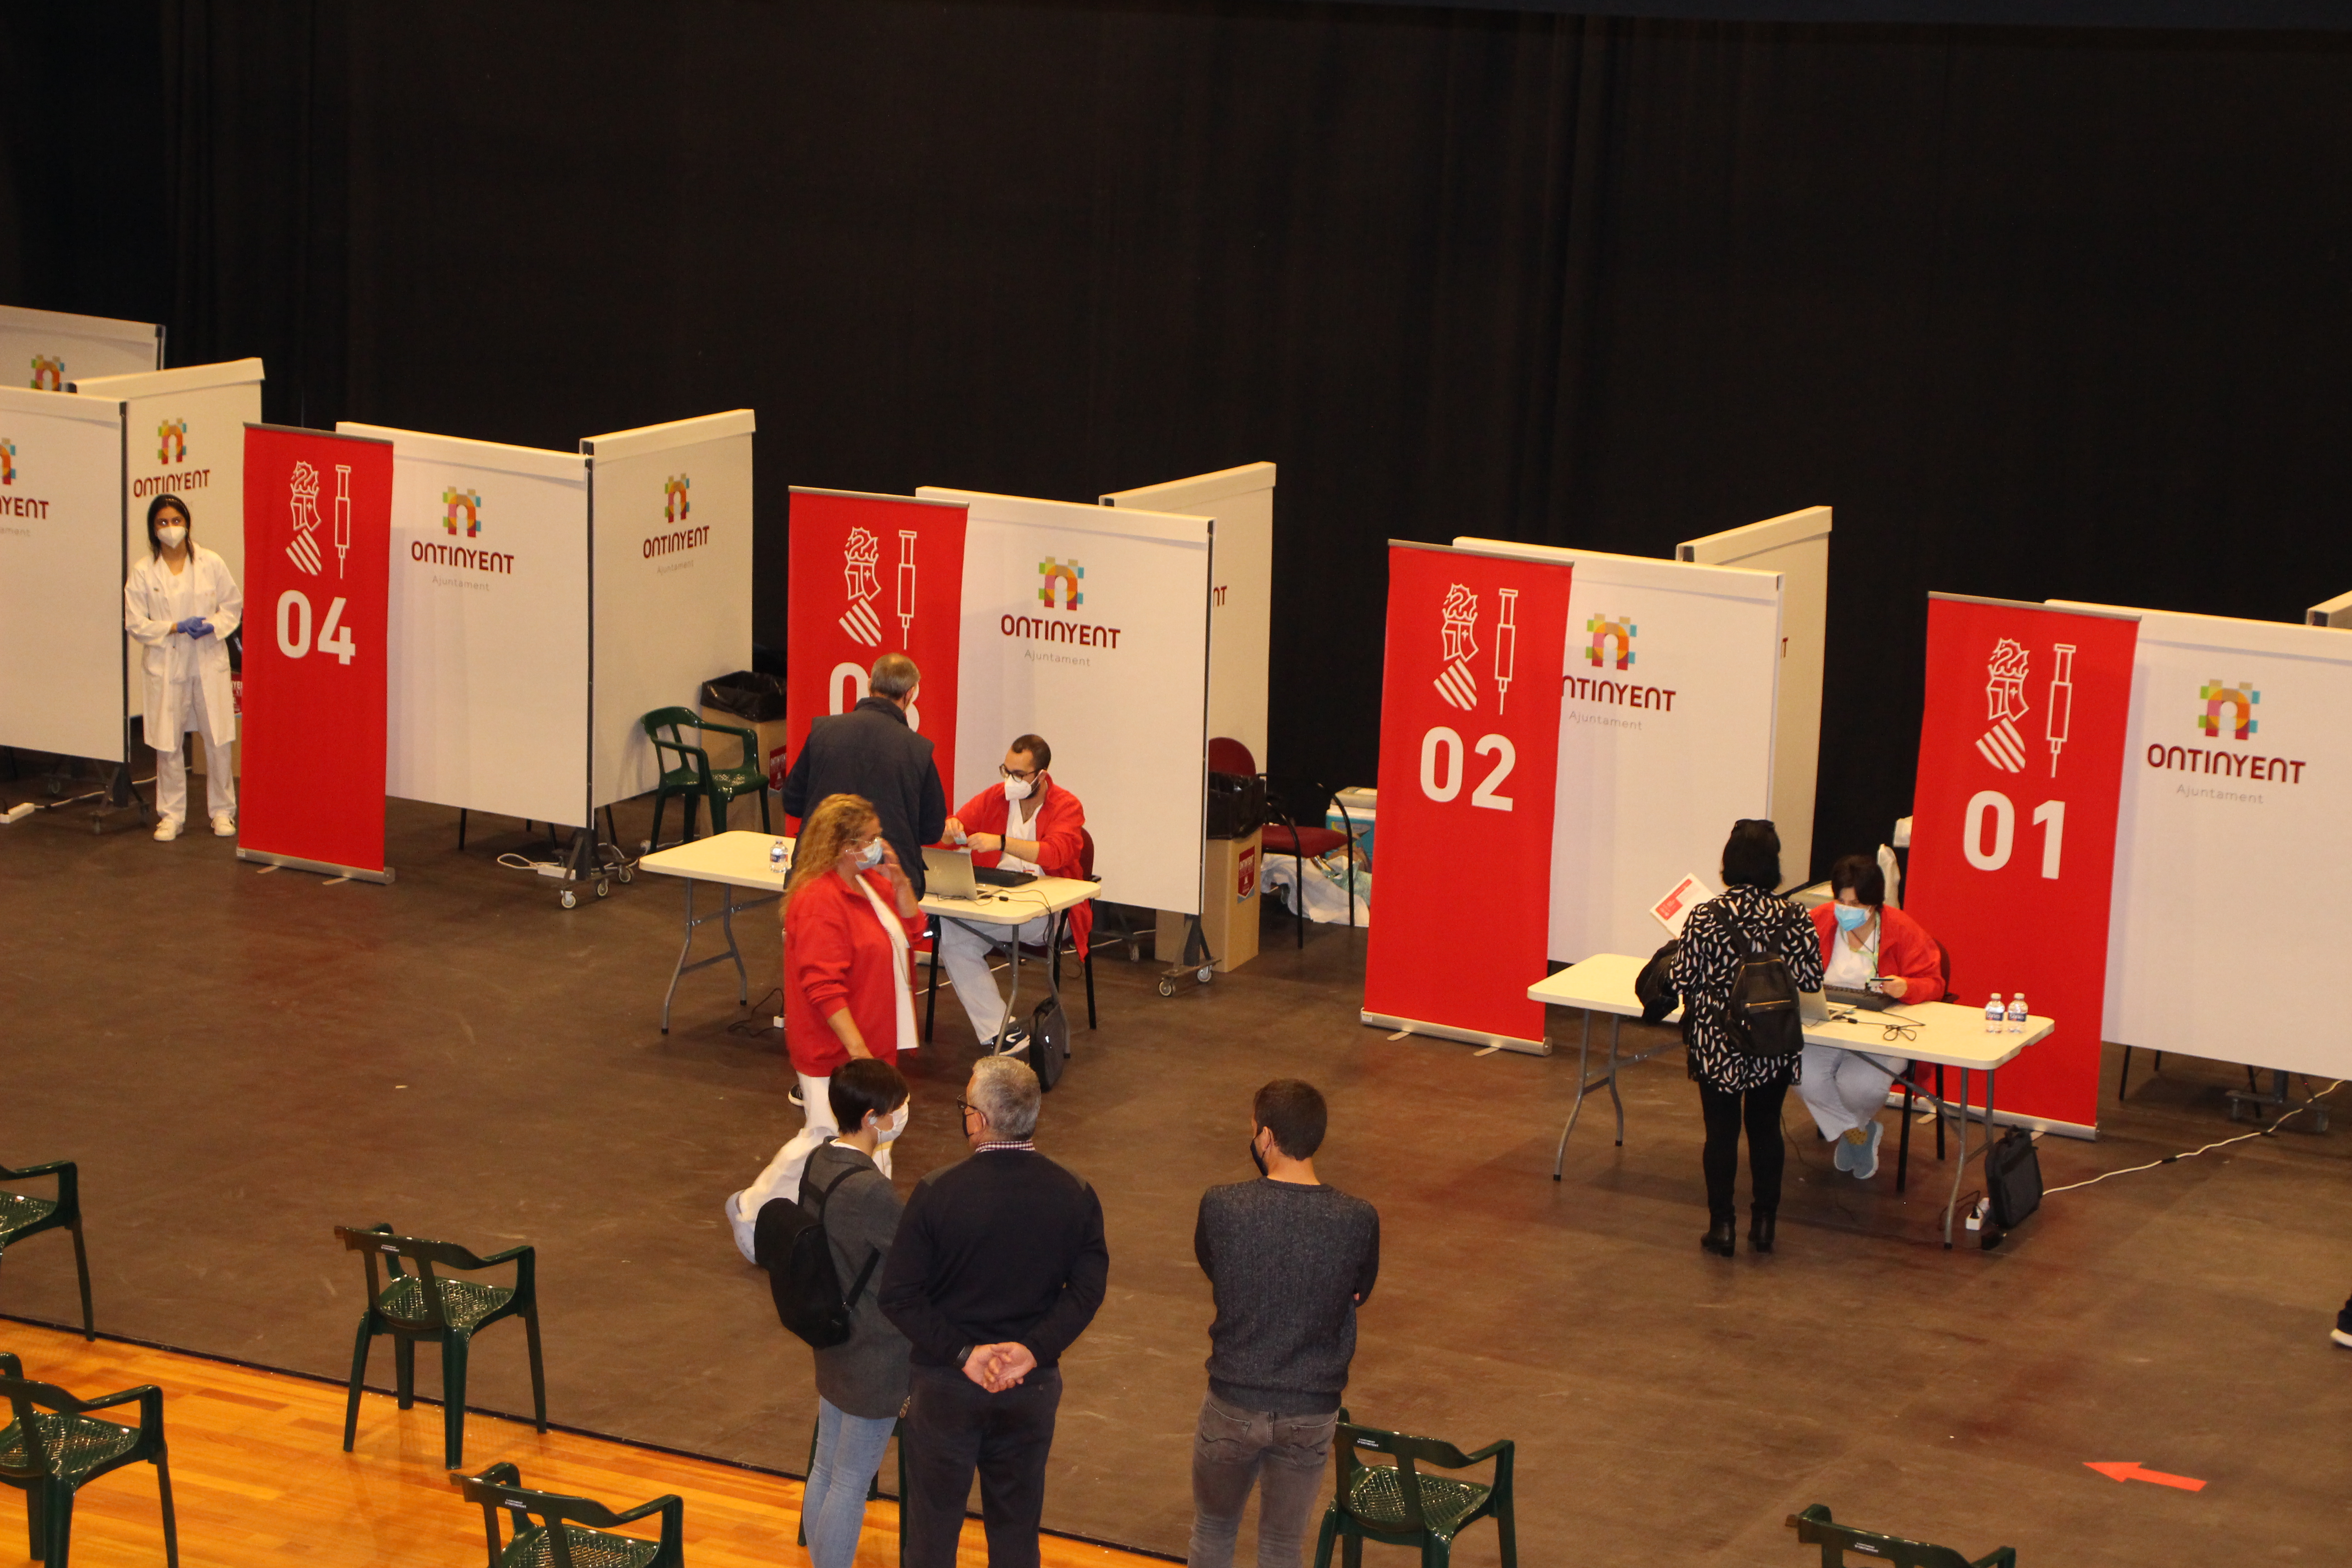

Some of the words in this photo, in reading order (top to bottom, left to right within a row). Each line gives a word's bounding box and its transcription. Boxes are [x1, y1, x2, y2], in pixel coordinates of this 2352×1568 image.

[133, 469, 210, 497] ONTINYENT
[0, 496, 49, 519] YENT
[411, 540, 514, 574] ONTINYENT
[643, 525, 710, 559] ONTINYENT
[432, 575, 490, 591] Ajuntament
[277, 590, 356, 665] 04
[1001, 614, 1121, 649] ONTINYENT
[1024, 649, 1091, 666] Ajuntament
[1562, 675, 1676, 711] NTINYENT
[1569, 710, 1642, 730] Ajuntament
[1420, 726, 1516, 812] 02
[2147, 743, 2306, 784] ONTINYENT
[2177, 784, 2264, 804] Ajuntament
[1963, 790, 2065, 879] 01
